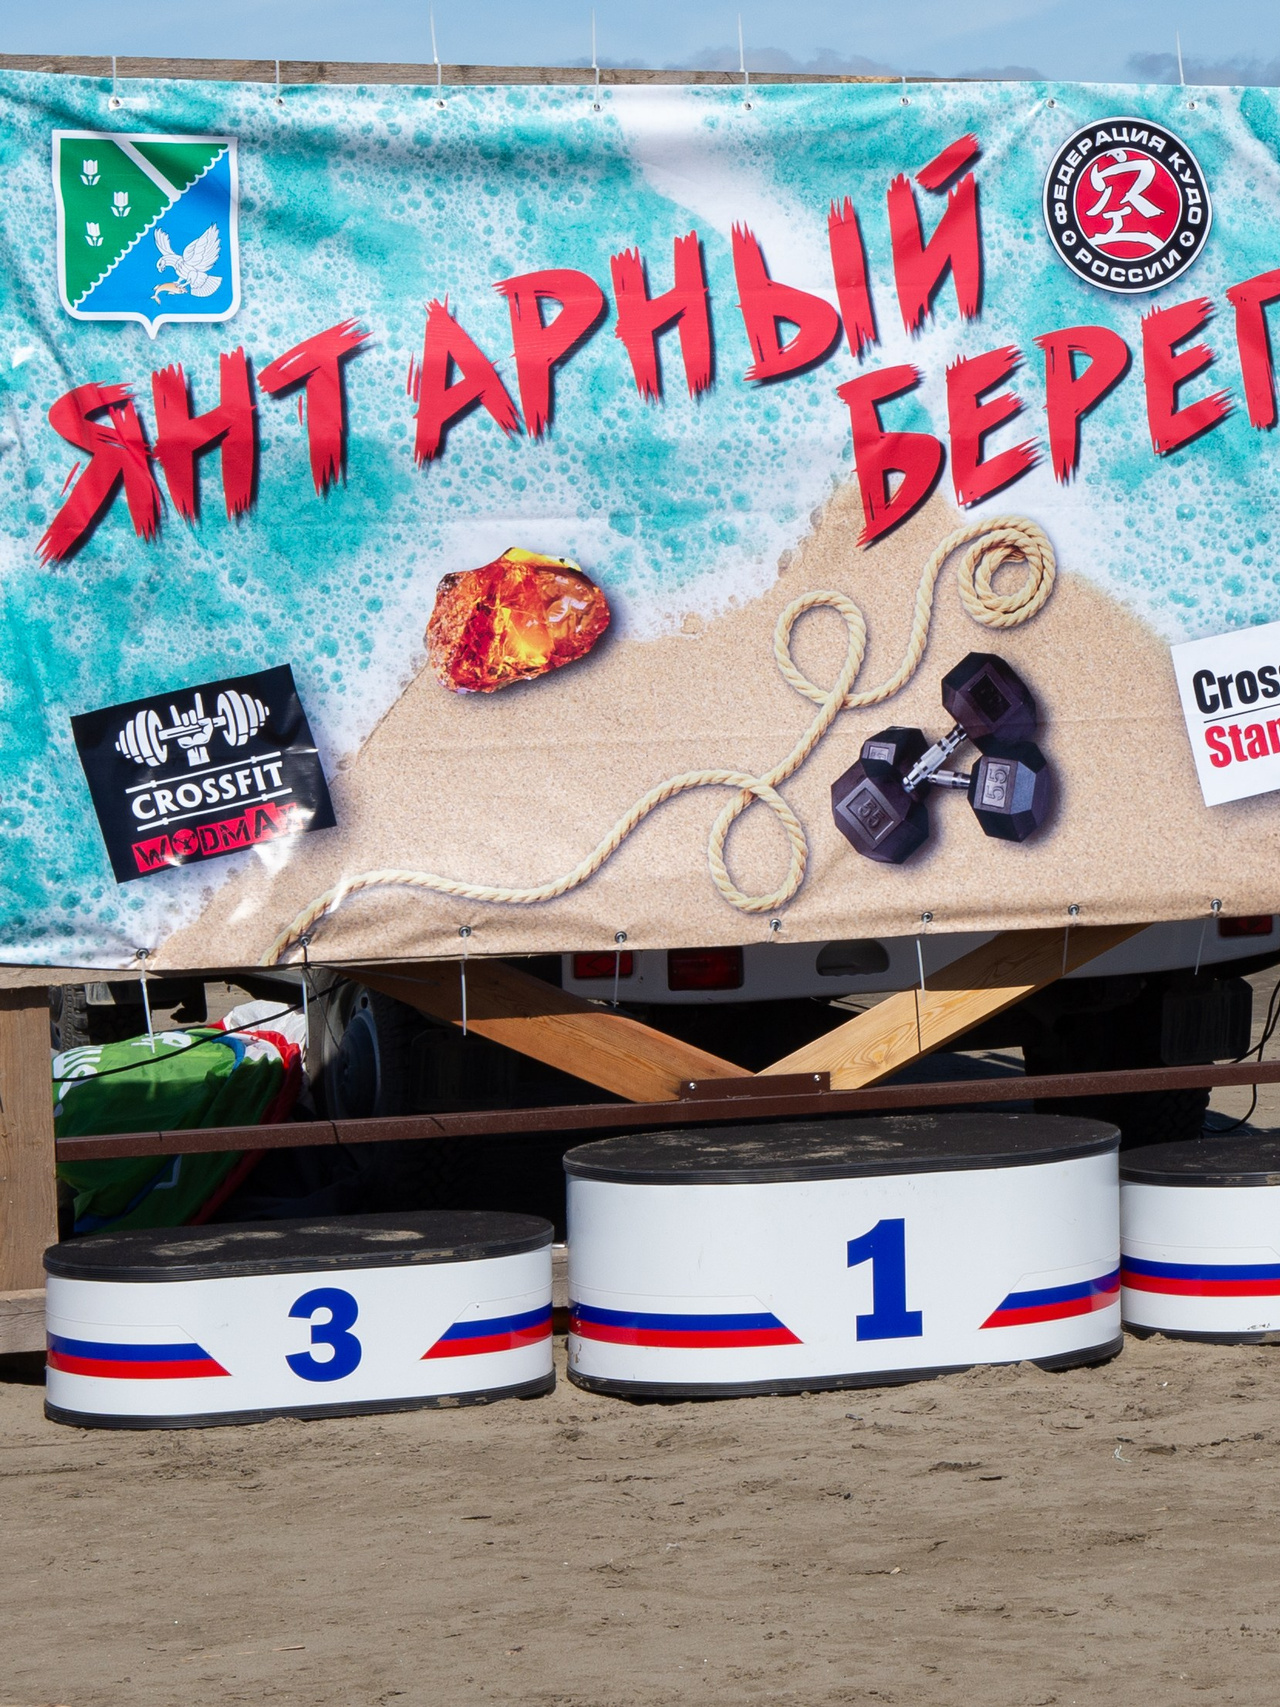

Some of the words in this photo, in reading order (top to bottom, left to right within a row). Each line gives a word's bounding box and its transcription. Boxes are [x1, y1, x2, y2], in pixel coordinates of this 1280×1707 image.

[1053, 127, 1167, 225] ФЕДЕРАЦИЯ
[1167, 151, 1203, 225] КУДО
[1074, 247, 1182, 283] РОССИИ
[131, 761, 283, 820] CROSSFIT
[857, 799, 886, 829] 55
[986, 768, 1008, 801] 55
[846, 1217, 923, 1342] 1
[284, 1286, 363, 1383] 3
